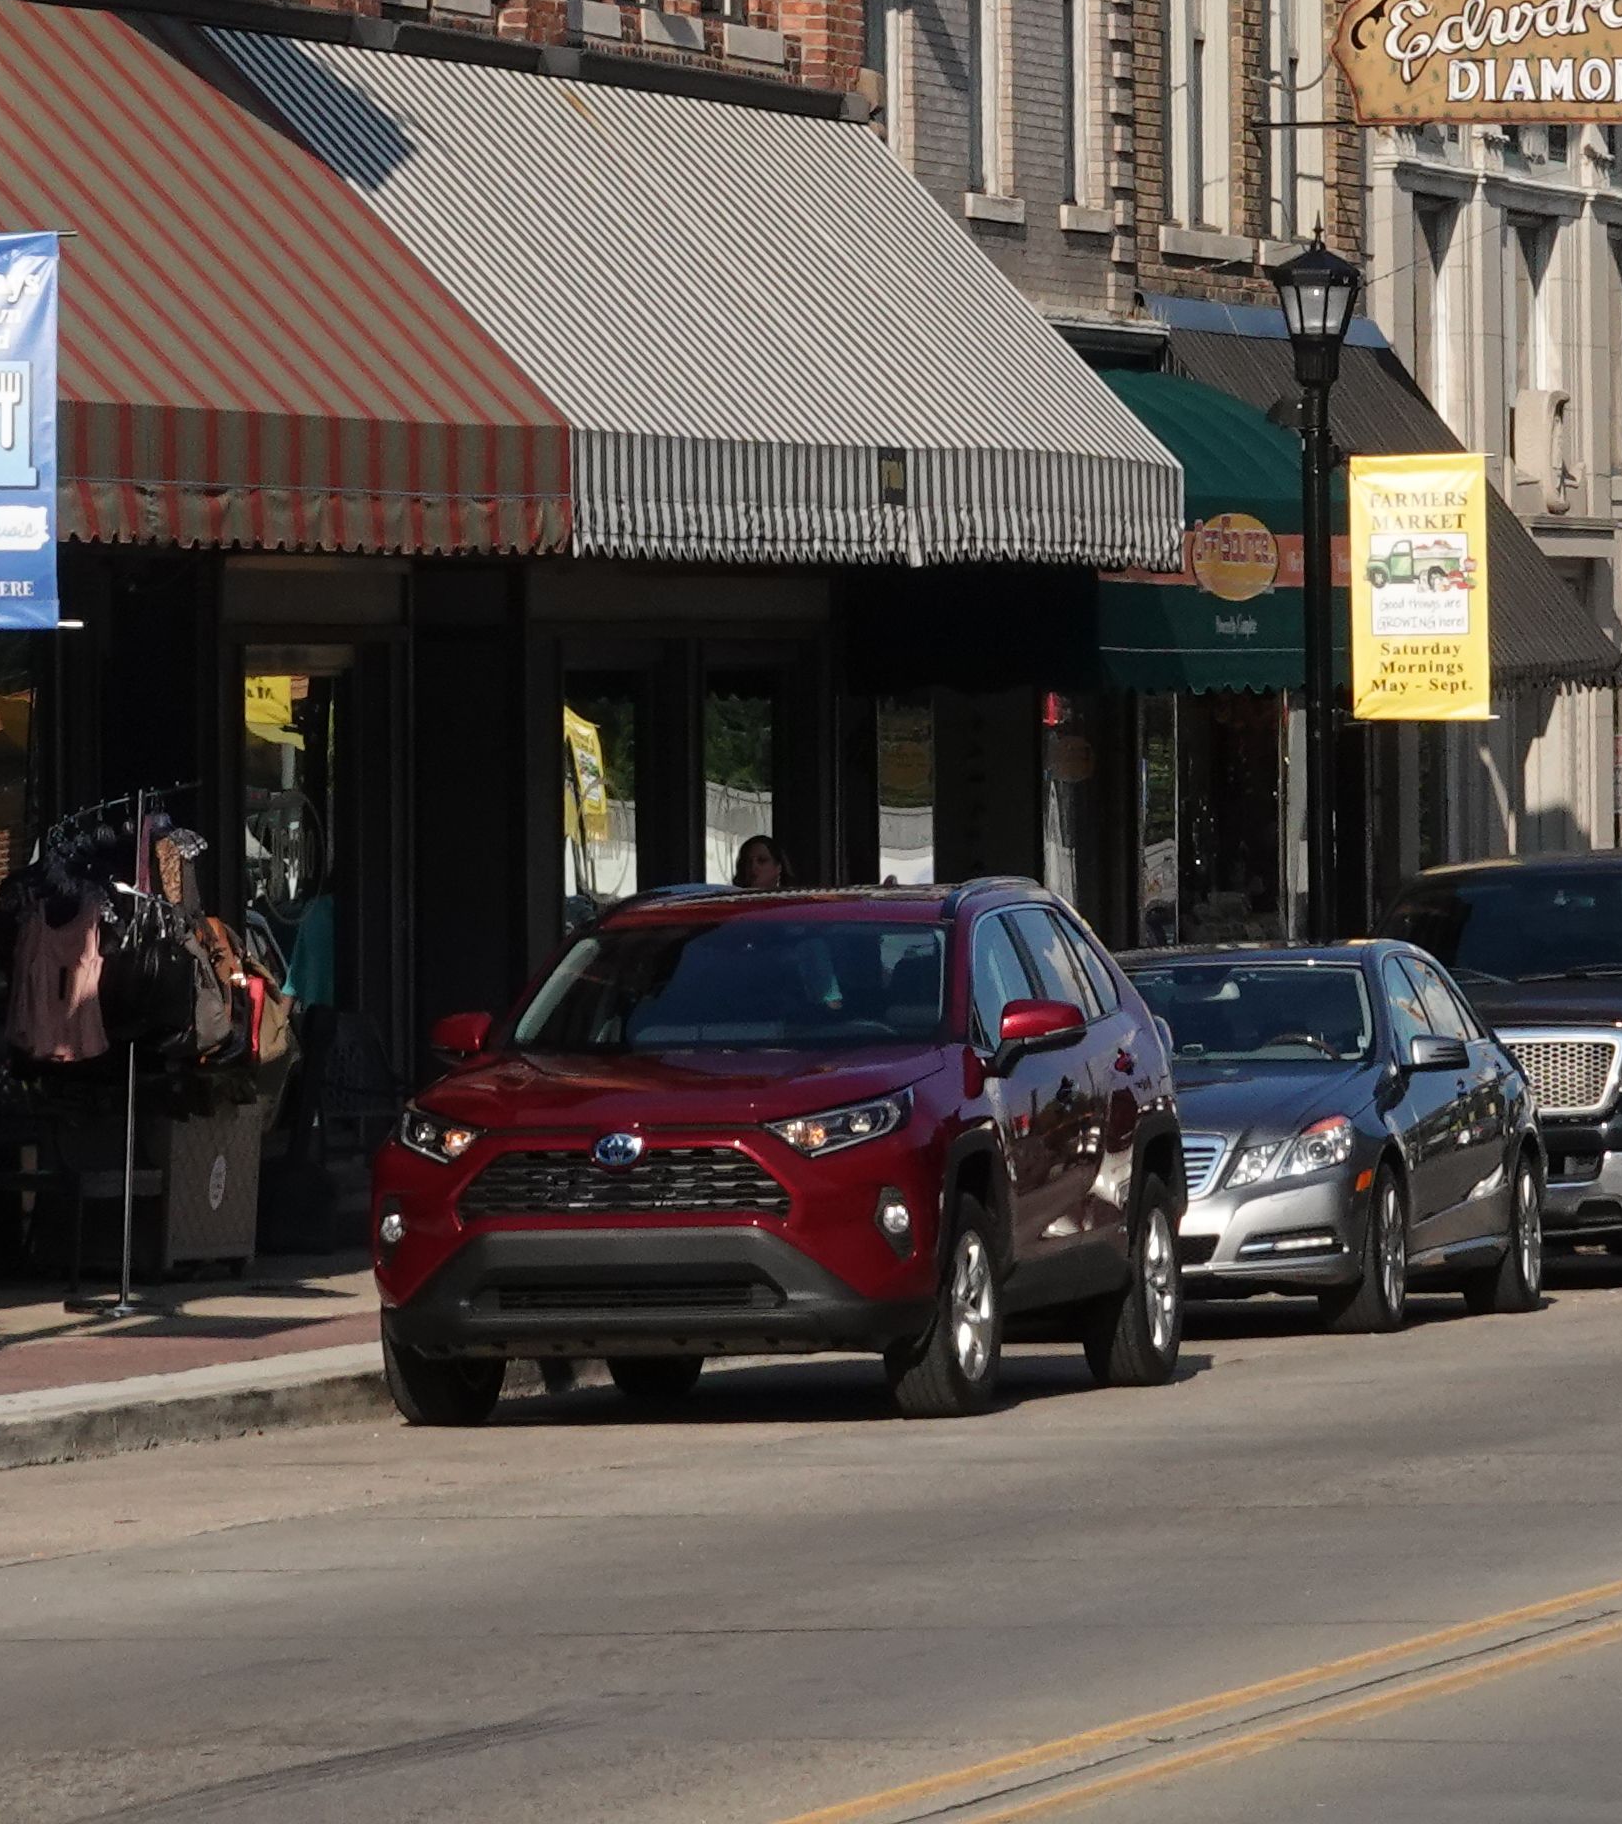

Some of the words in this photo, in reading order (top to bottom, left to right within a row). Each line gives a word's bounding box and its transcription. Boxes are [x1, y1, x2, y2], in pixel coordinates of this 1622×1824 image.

[1369, 491, 1469, 509] FARMERS
[1371, 513, 1466, 530] MARKET
[1380, 642, 1462, 656] Saturday
[1379, 661, 1464, 675] Mornings
[1370, 679, 1410, 694] May
[1429, 678, 1473, 693] Sept.
